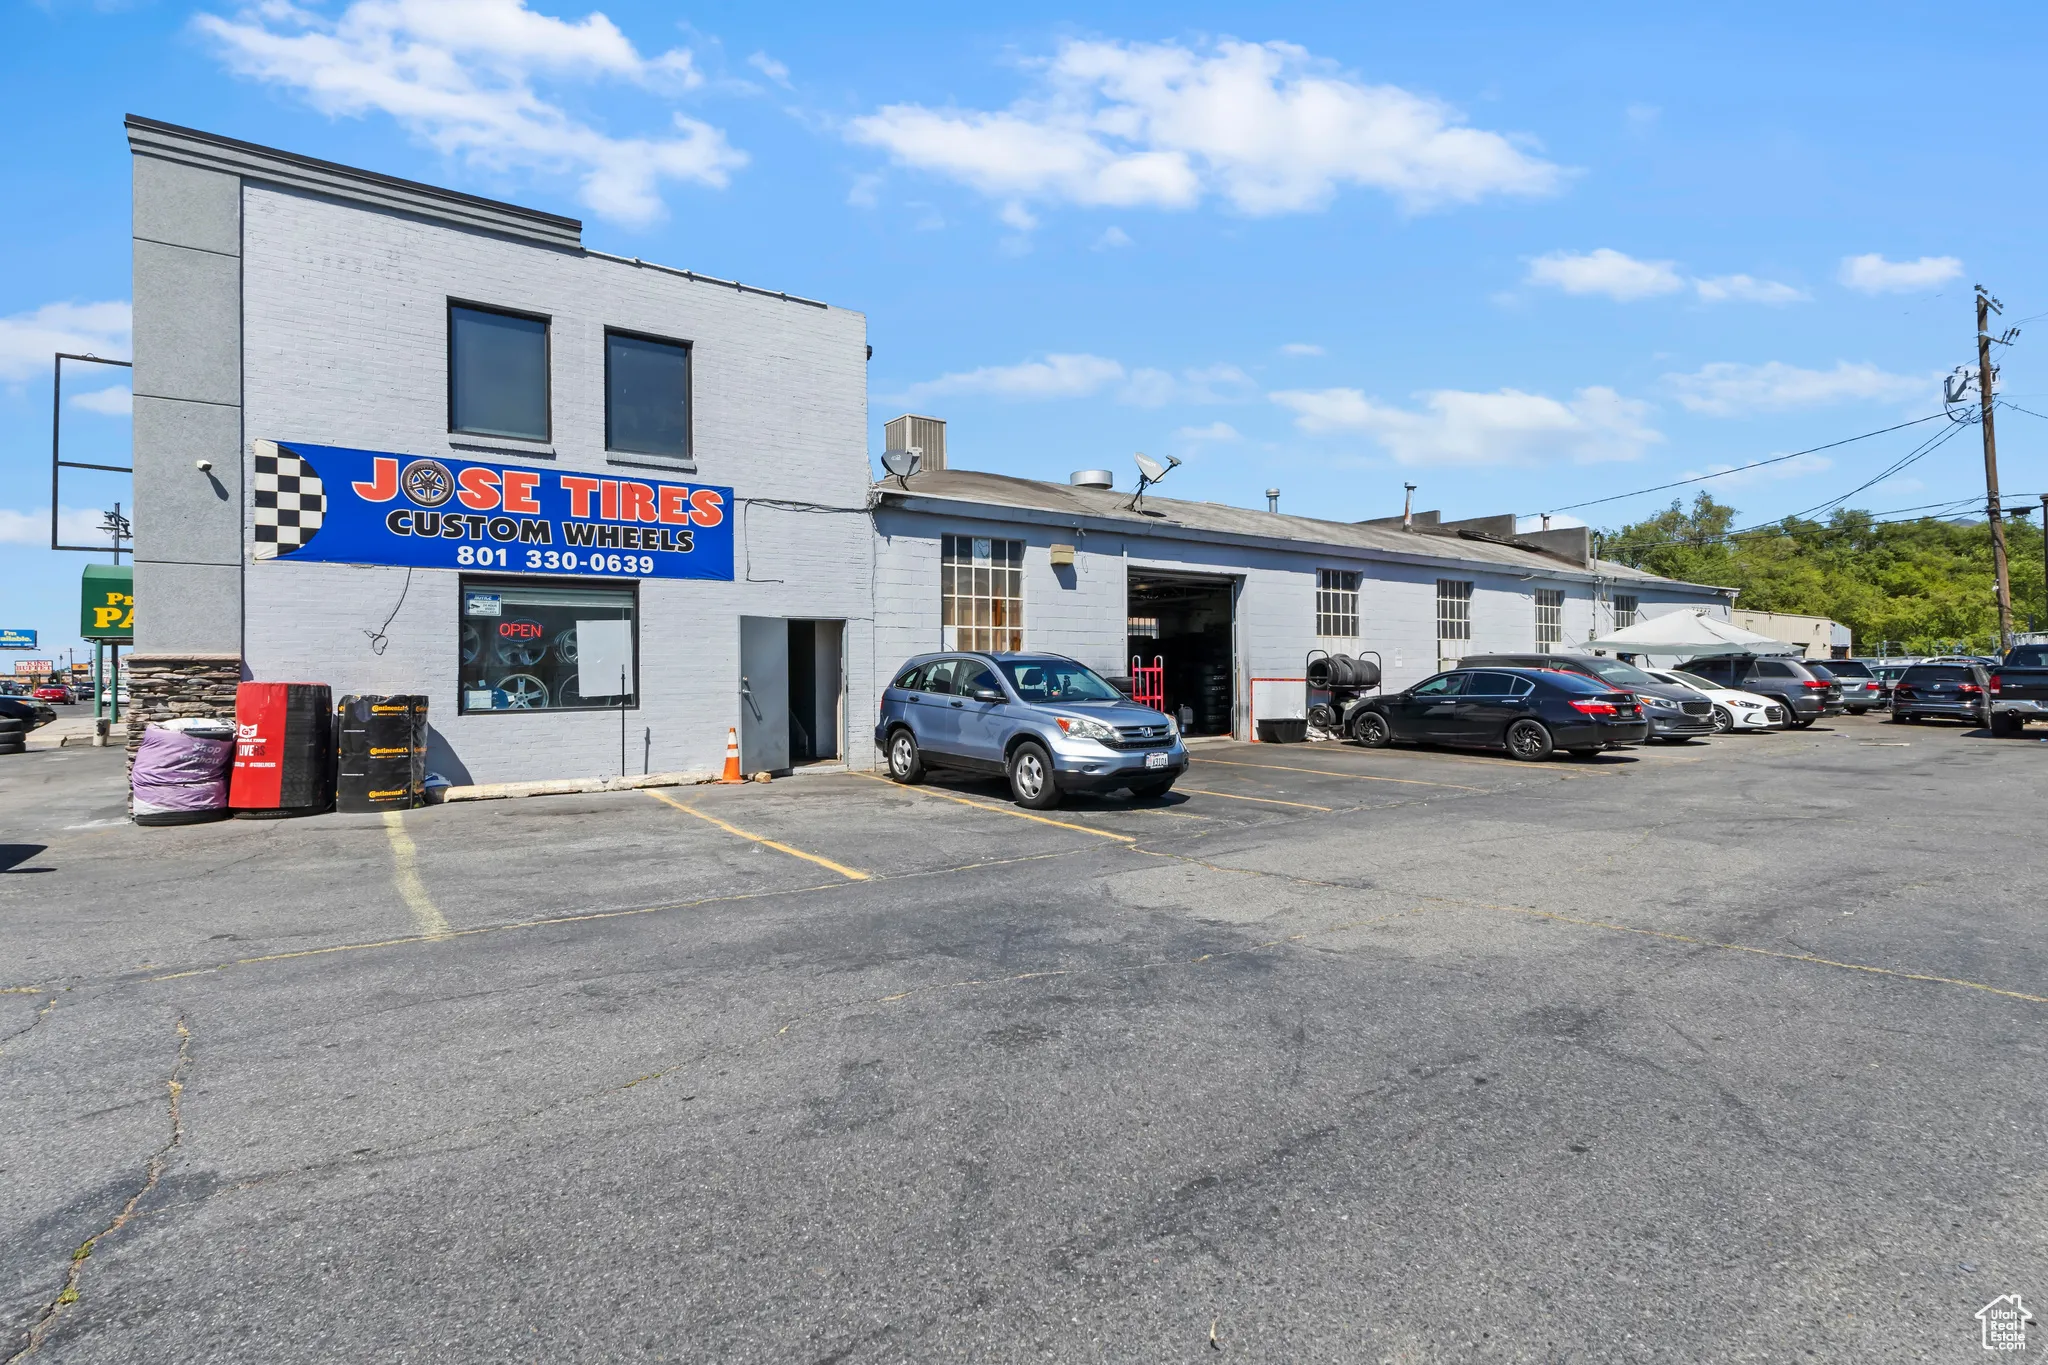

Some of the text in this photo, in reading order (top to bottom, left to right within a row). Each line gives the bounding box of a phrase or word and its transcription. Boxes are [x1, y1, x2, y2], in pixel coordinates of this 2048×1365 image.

[351, 457, 725, 528] JOSE TIRES
[386, 508, 695, 554] CUSTOM WHEELS
[457, 546, 654, 574] 801 330-0639
[499, 623, 542, 637] OPEN
[241, 728, 255, 736] GT
[192, 742, 222, 755] Shop
[369, 747, 404, 756] Continental
[368, 789, 403, 798] Continental
